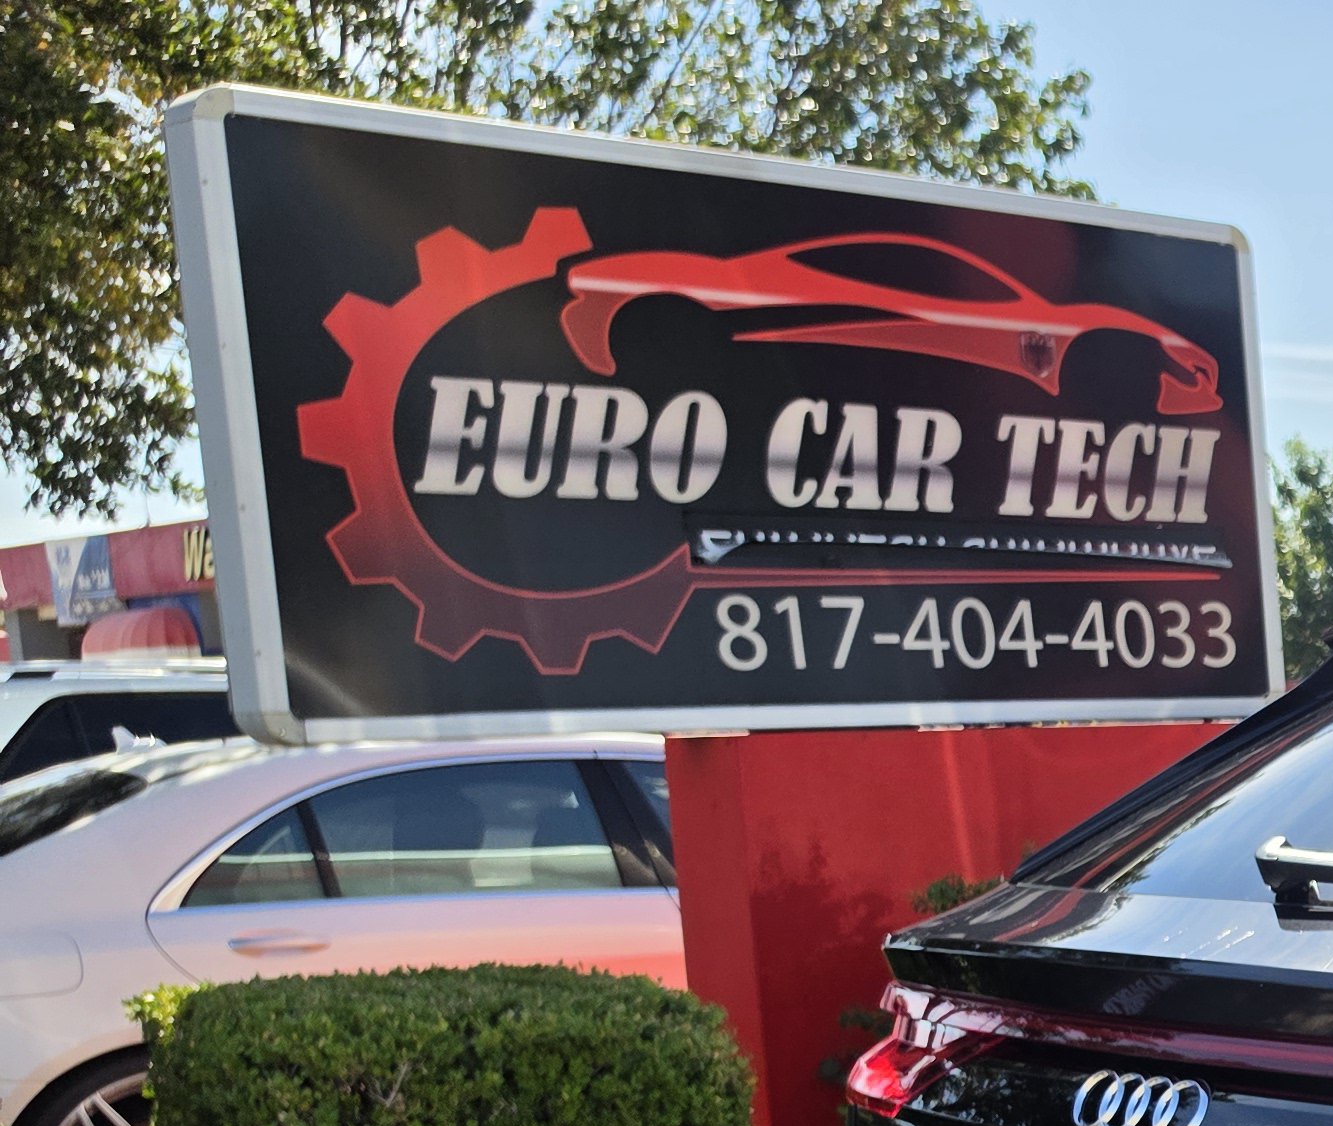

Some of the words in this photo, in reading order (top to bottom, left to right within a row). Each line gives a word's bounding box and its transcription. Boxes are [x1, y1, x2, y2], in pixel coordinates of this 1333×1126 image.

[413, 376, 728, 504] EURO
[765, 397, 963, 513] CAR
[997, 415, 1222, 524] TECH
[716, 593, 1237, 672] 817-404-4033
